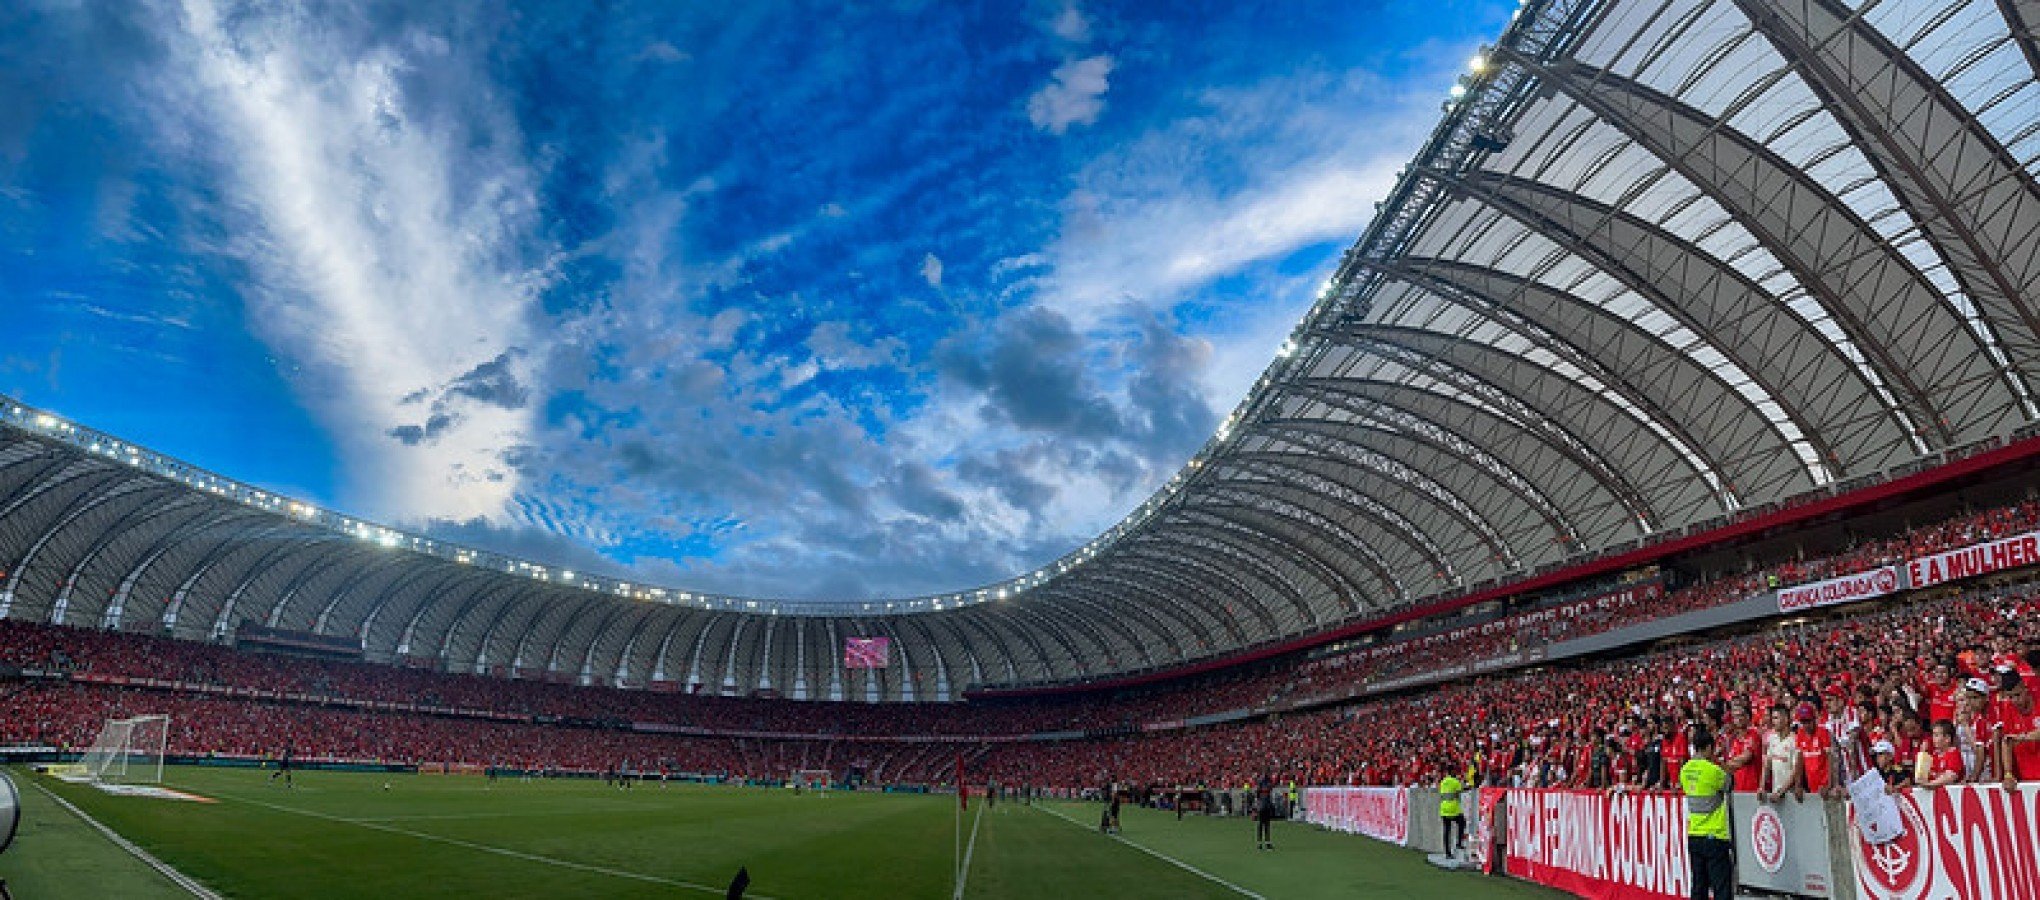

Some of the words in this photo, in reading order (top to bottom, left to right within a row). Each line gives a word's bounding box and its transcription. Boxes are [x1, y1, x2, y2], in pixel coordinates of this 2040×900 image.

[1909, 562, 1923, 587] E
[1927, 559, 1942, 582] A
[1946, 537, 2039, 580] MULHER
[1544, 791, 1609, 880] FEMININA
[1933, 785, 2040, 900] SOM
